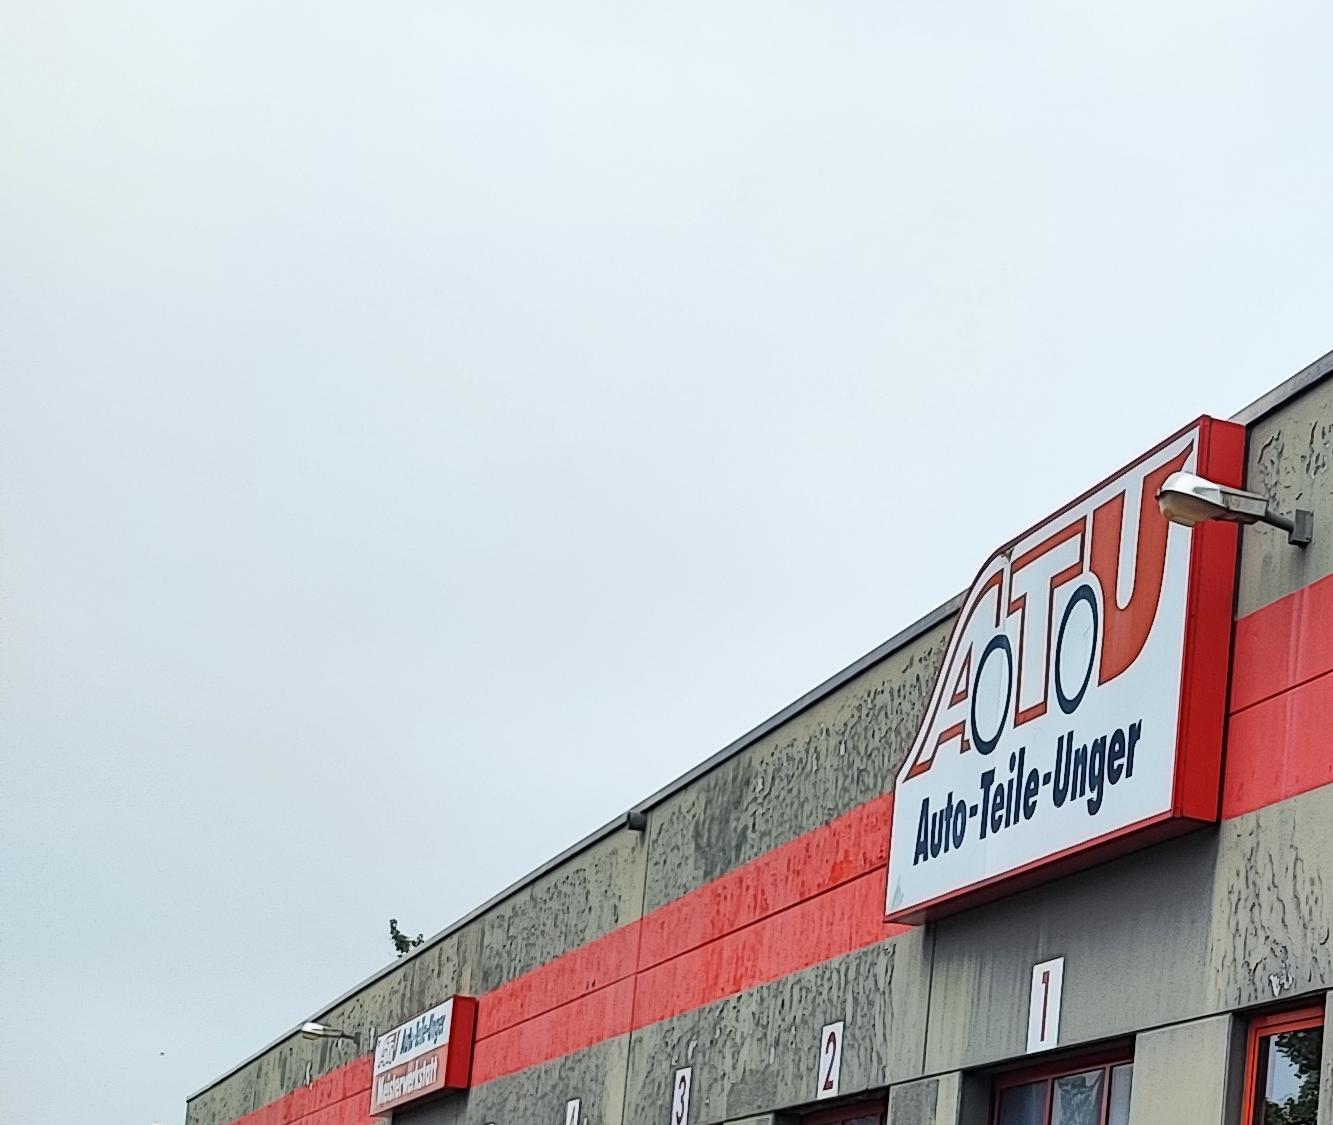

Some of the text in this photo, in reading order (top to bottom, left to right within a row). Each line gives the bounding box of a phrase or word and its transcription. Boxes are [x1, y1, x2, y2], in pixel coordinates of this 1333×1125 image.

[913, 716, 1143, 868] Auto-Teile-Unger
[1039, 970, 1050, 1042] 1
[823, 1030, 837, 1092] 2
